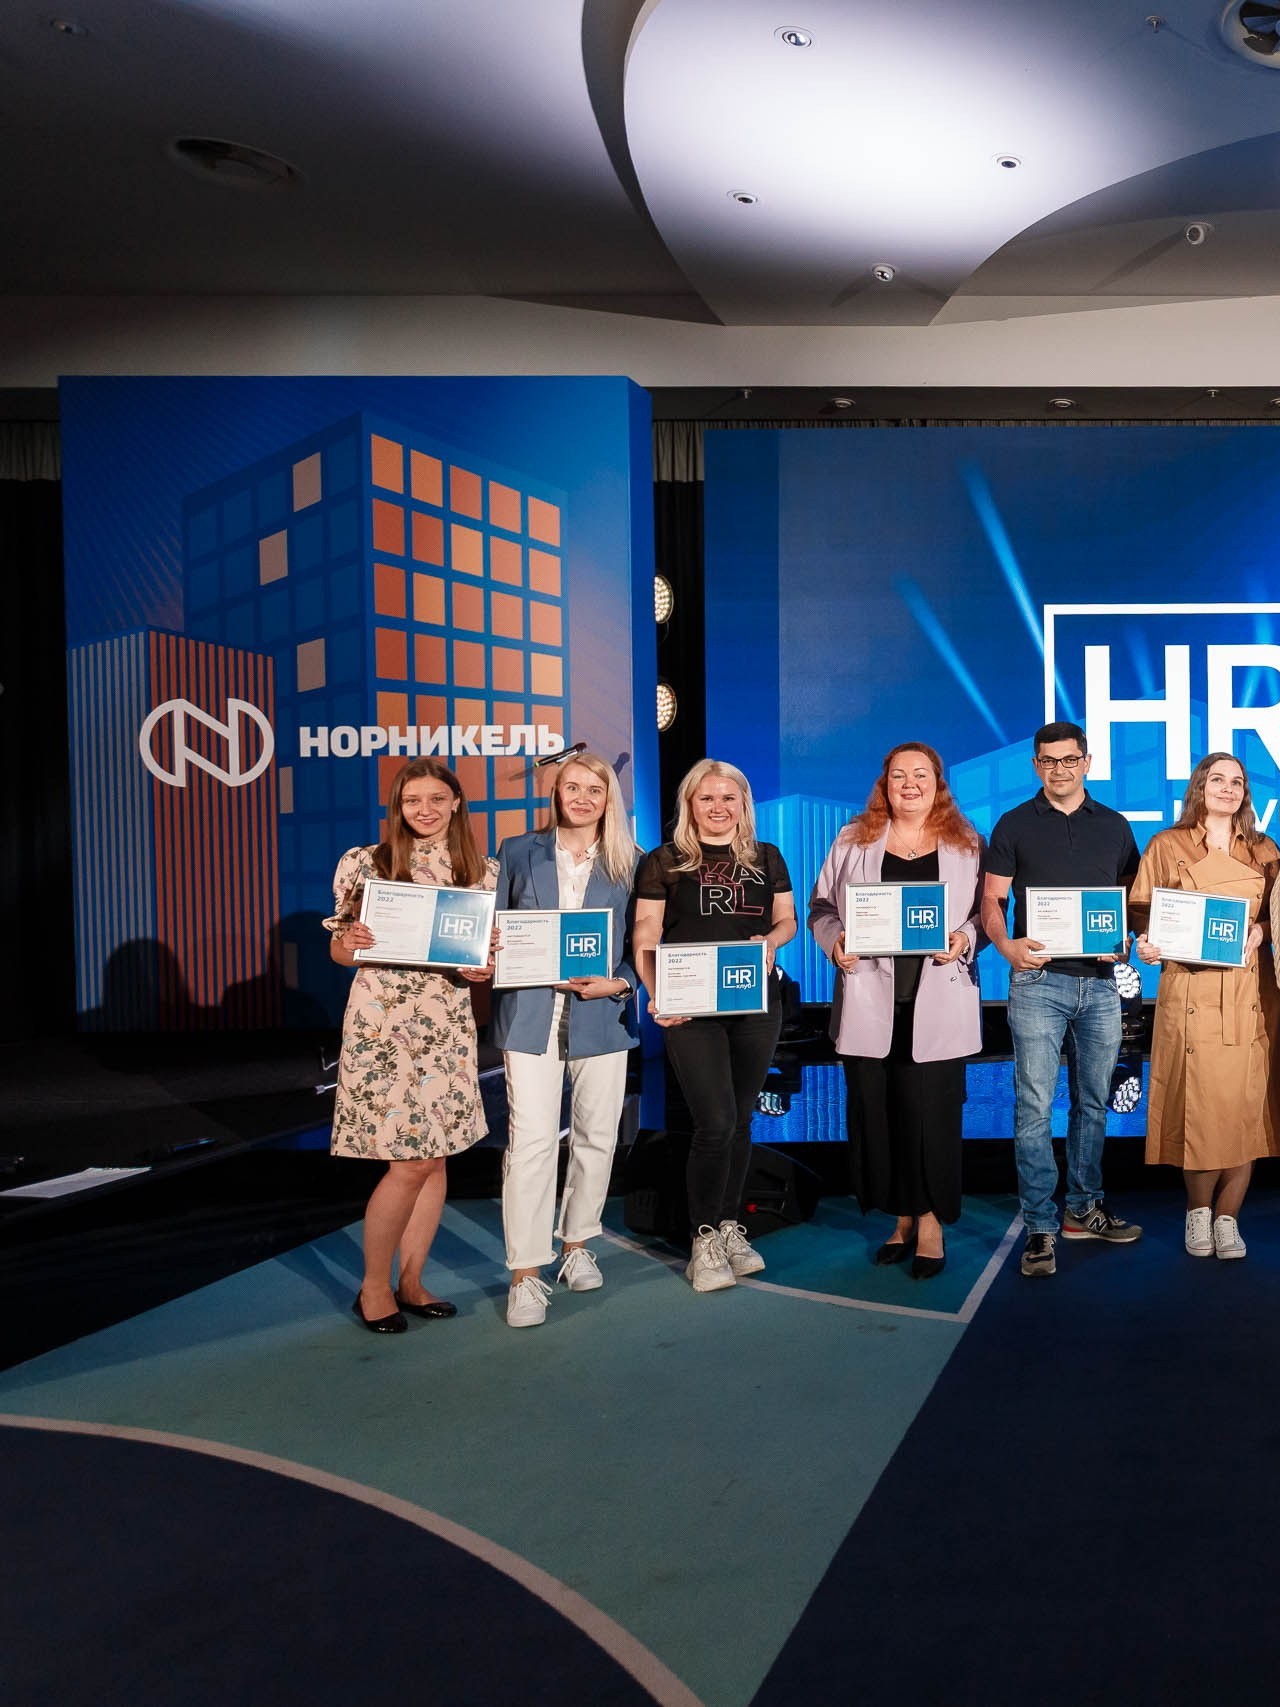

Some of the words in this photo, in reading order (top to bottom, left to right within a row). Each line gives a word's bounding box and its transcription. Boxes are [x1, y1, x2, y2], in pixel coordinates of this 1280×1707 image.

[299, 725, 566, 758] НОРНИКЕЛЬ
[910, 909, 935, 925] HR
[1090, 914, 1113, 928] HR
[443, 917, 474, 935] HR
[1211, 922, 1235, 937] HR
[569, 937, 597, 953] HR
[727, 969, 752, 984] HR
